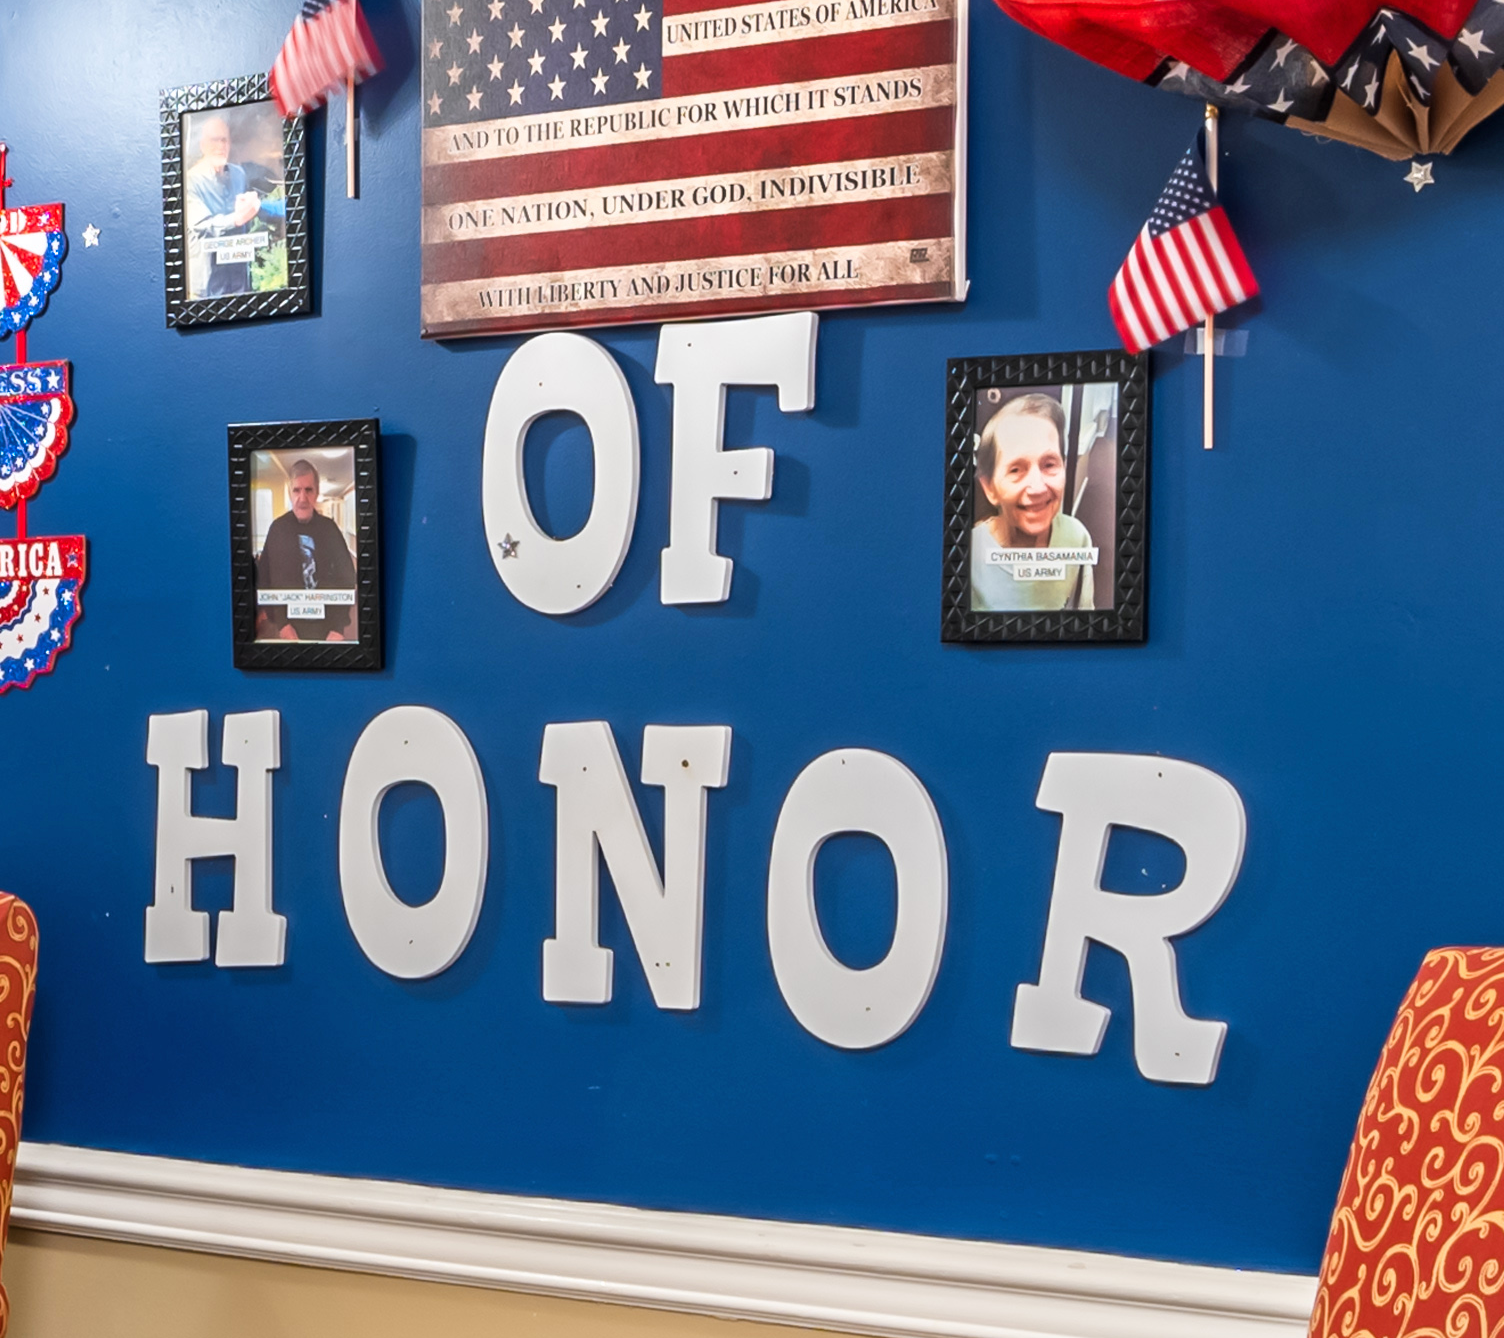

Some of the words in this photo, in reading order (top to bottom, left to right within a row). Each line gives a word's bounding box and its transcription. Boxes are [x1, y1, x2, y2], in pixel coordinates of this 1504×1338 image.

[666, 16, 737, 44] UNITED
[741, 6, 811, 35] STATES
[815, 2, 842, 24] OF
[448, 130, 489, 153] AND
[493, 126, 520, 147] TO
[524, 120, 565, 143] THE
[570, 107, 672, 138] REPUBLIC
[676, 102, 718, 125] FOR
[723, 92, 801, 119] WHICH
[807, 88, 829, 110] IT
[833, 77, 922, 107] STANDS
[448, 208, 495, 231] ONE
[500, 198, 595, 226] NATION,
[602, 188, 686, 215] UNDER
[692, 183, 752, 206] GOD,
[760, 164, 921, 200] INDIVISIBLE
[478, 285, 532, 308] WITH
[537, 279, 622, 305] LIBERTY
[626, 274, 671, 297] AND
[675, 267, 762, 293] JUSTICE
[769, 263, 811, 285] FOR
[817, 259, 859, 281] ALL
[482, 312, 819, 616] OF
[991, 552, 1033, 562] CYNTHIA
[1036, 552, 1094, 561] BASAMANIA
[1018, 568, 1032, 578] US
[1034, 567, 1063, 577] ARMY
[259, 593, 279, 601] JOHN
[305, 593, 353, 601] HARRINGTON
[290, 607, 299, 615] US
[302, 607, 322, 615] ARMY
[143, 704, 1245, 1084] HONOR
